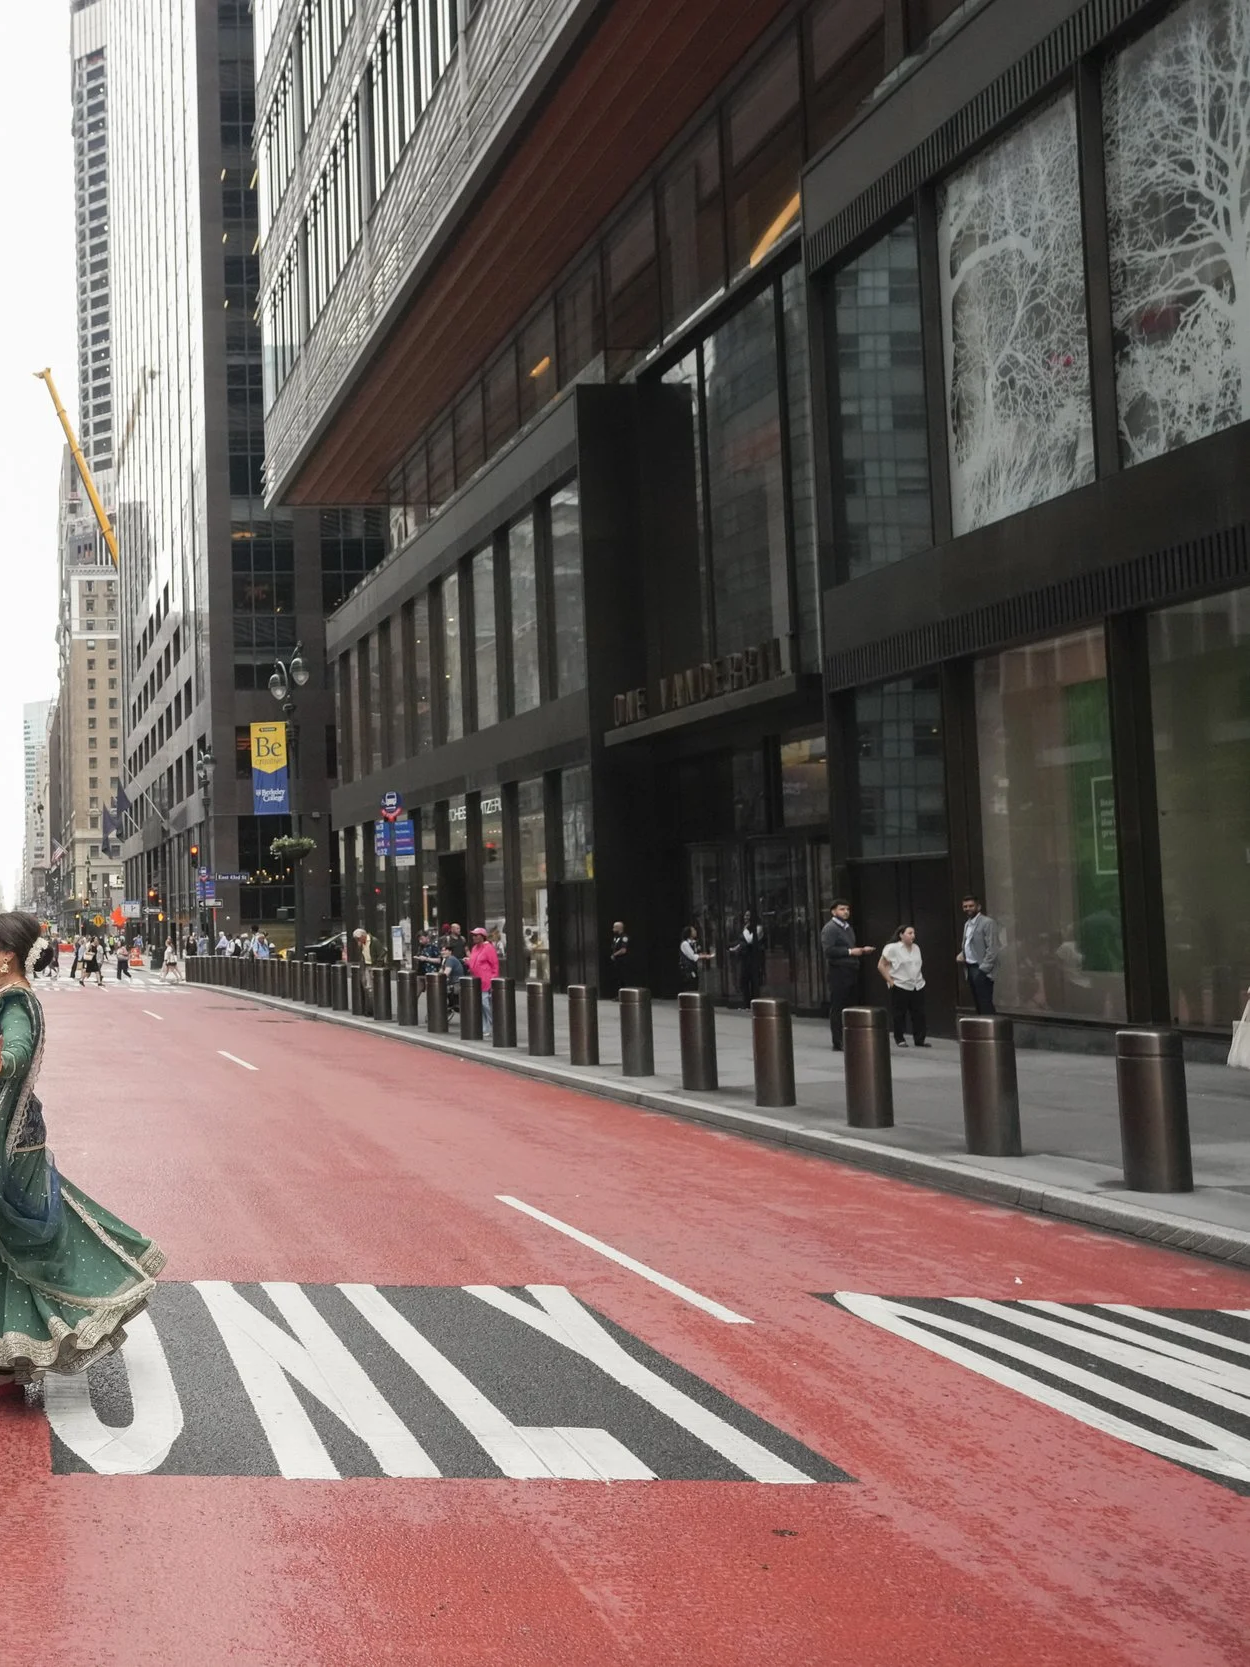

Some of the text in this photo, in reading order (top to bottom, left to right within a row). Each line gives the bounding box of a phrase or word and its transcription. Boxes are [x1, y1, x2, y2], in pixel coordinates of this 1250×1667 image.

[613, 687, 648, 727] ONE
[254, 736, 283, 758] Be
[44, 1281, 816, 1484] ONLY
